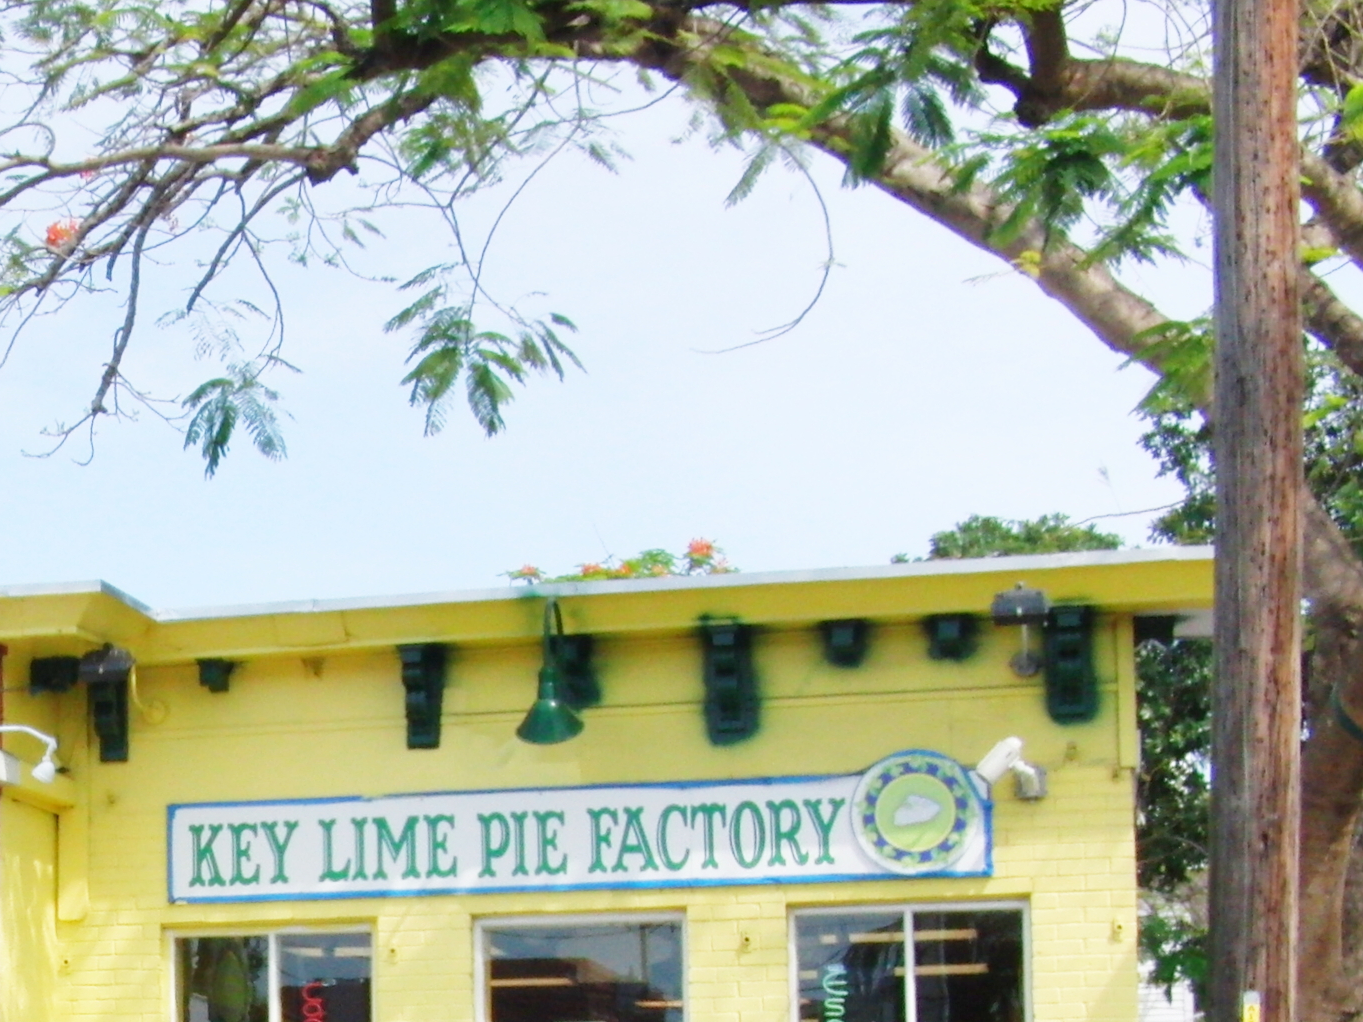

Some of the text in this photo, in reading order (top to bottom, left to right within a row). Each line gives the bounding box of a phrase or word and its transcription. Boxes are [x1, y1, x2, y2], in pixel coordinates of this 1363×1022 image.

[188, 798, 846, 888] KEY LIME PIE FACTORY
